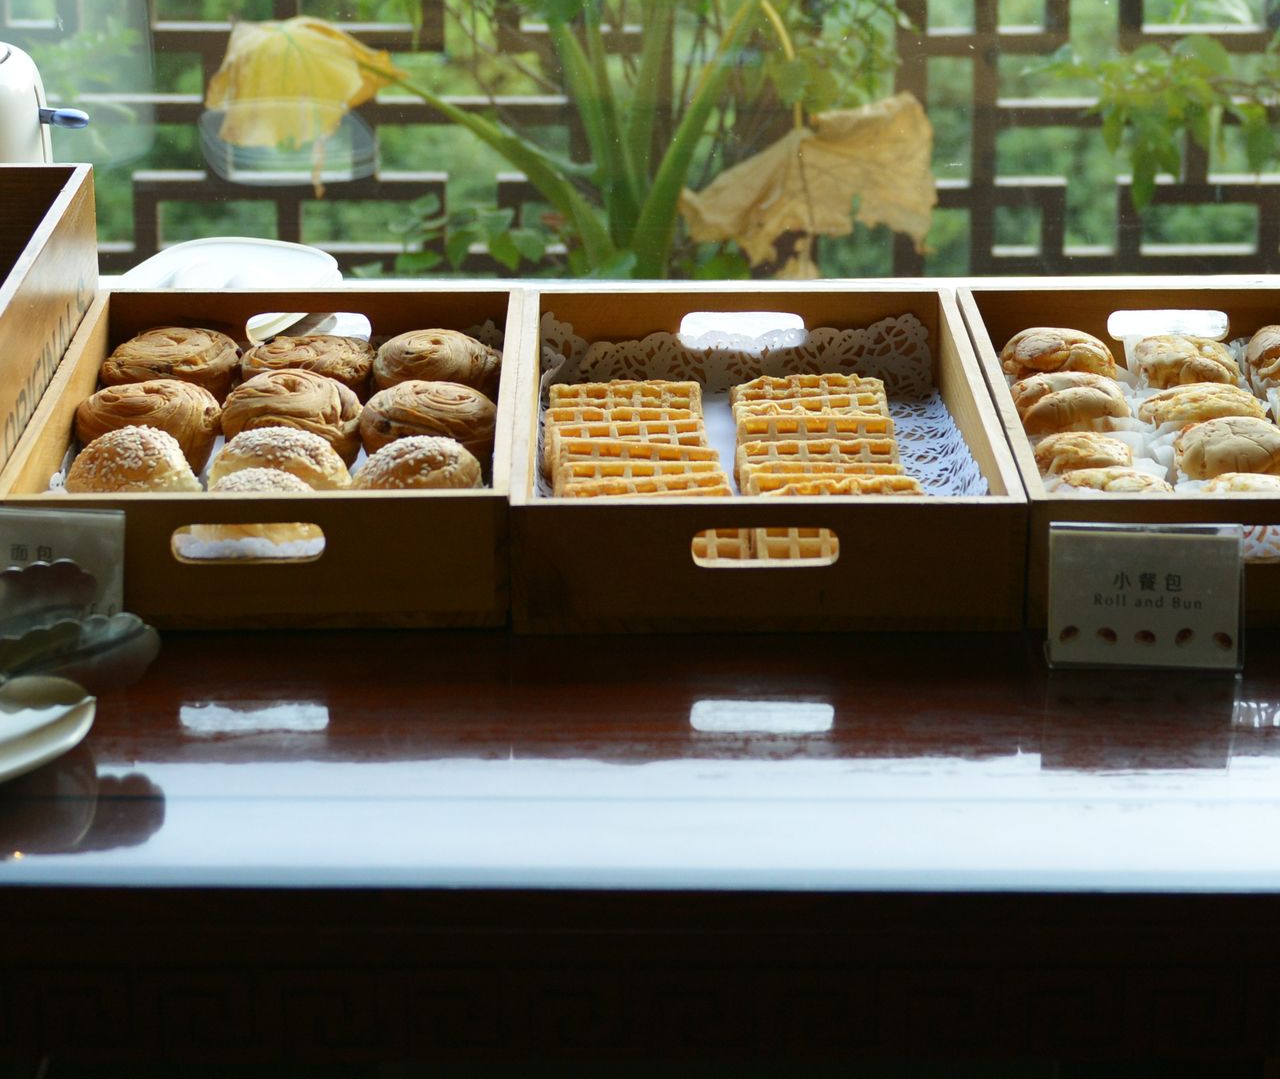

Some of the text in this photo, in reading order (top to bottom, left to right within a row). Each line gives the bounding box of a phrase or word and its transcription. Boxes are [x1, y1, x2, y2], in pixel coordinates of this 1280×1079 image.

[1112, 571, 1183, 592] 小餐包
[1094, 592, 1203, 610] Roll and Bun
